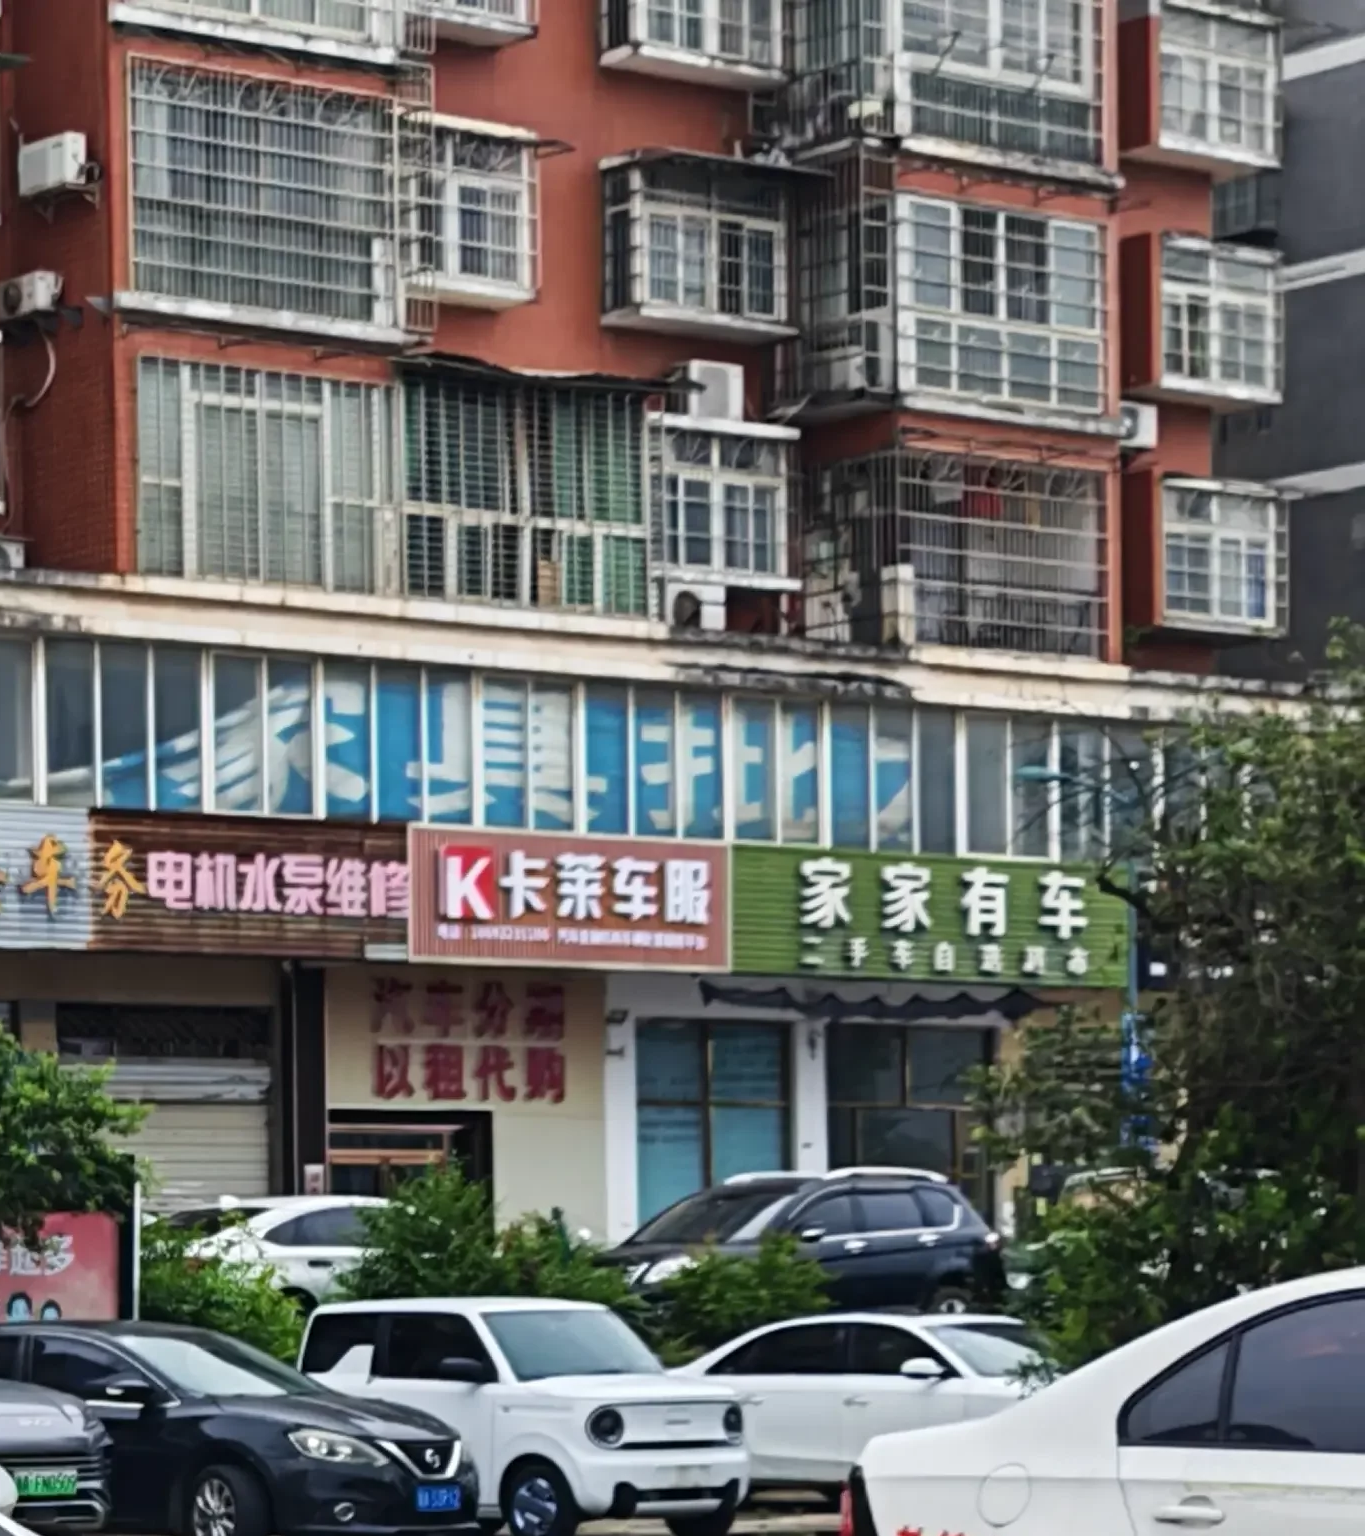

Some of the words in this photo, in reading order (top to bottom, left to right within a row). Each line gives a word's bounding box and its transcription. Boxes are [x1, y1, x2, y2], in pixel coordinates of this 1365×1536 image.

[147, 849, 411, 920] 电机水泵维修
[446, 856, 495, 919] K
[498, 850, 711, 925] 卡莱车服
[799, 856, 1090, 940] 家家有车
[373, 1042, 566, 1104] 以租代购
